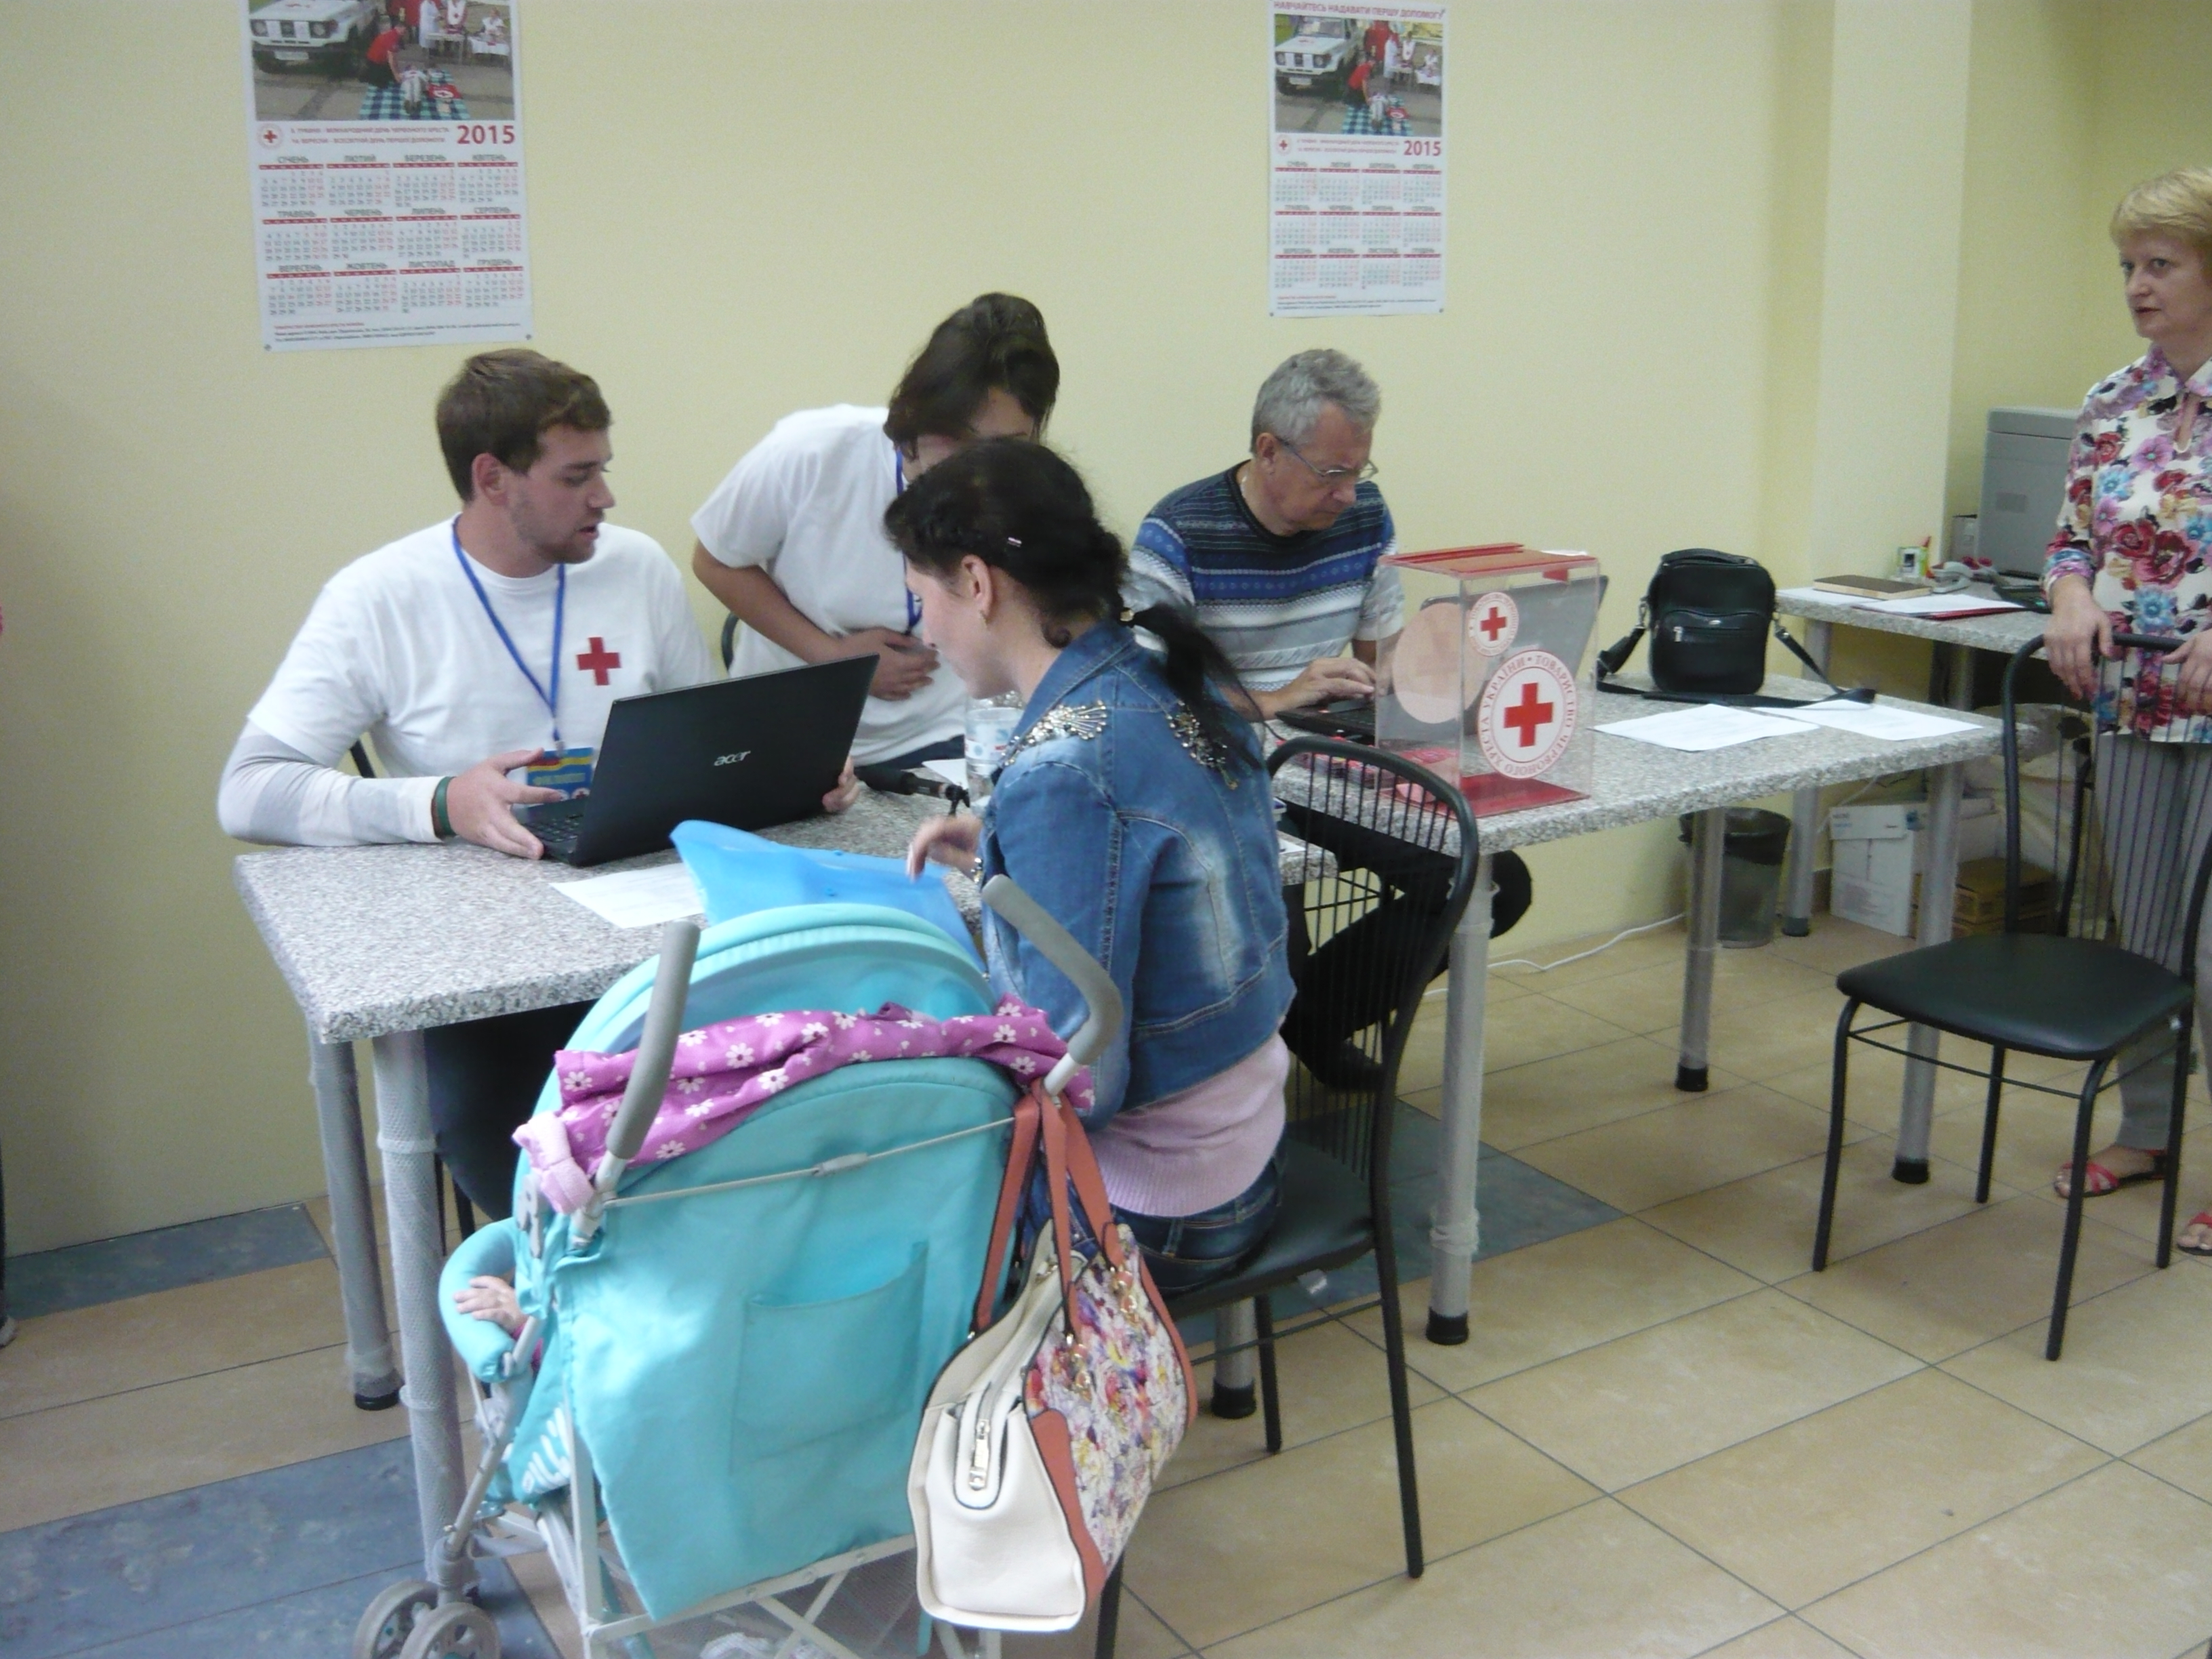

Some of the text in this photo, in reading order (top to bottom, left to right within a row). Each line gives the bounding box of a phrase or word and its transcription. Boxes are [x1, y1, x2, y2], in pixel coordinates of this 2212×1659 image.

[457, 125, 516, 144] 2015
[1404, 140, 1442, 157] 2015
[1534, 655, 1574, 728] ТОВАРИСТВО
[714, 750, 751, 766] acer
